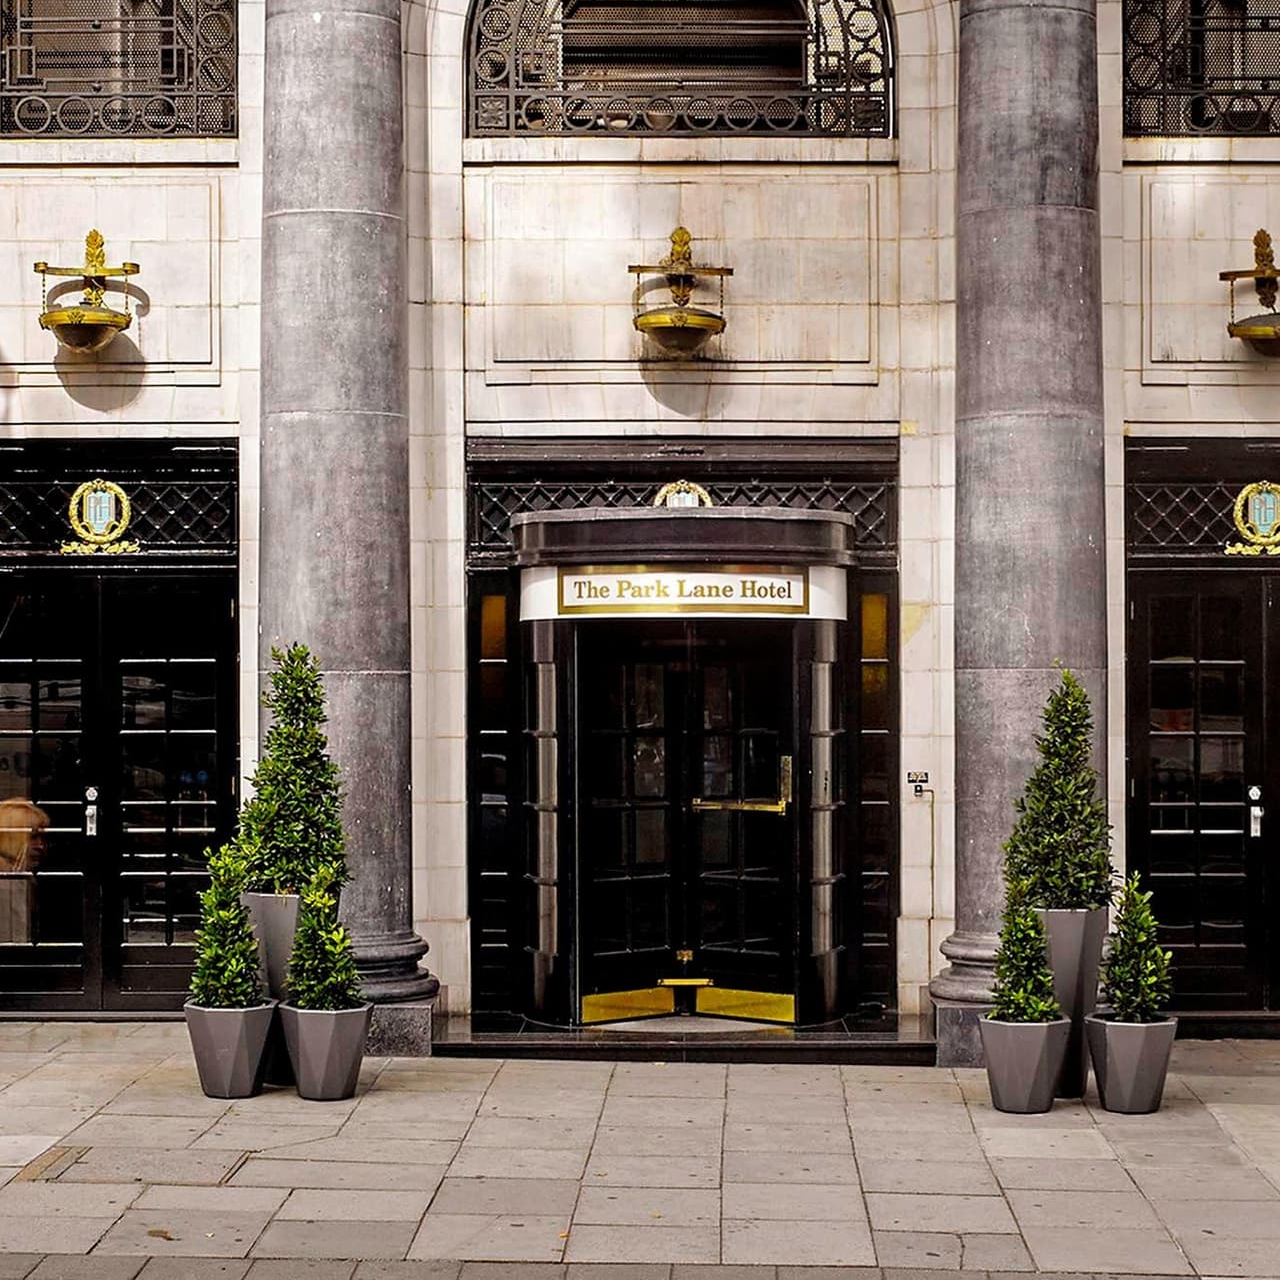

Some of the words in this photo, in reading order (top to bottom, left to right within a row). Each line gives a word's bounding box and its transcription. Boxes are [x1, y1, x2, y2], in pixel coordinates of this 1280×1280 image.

[573, 579, 610, 600] The
[617, 578, 669, 599] Park
[677, 578, 733, 599] Lane
[739, 579, 793, 600] Hotel
